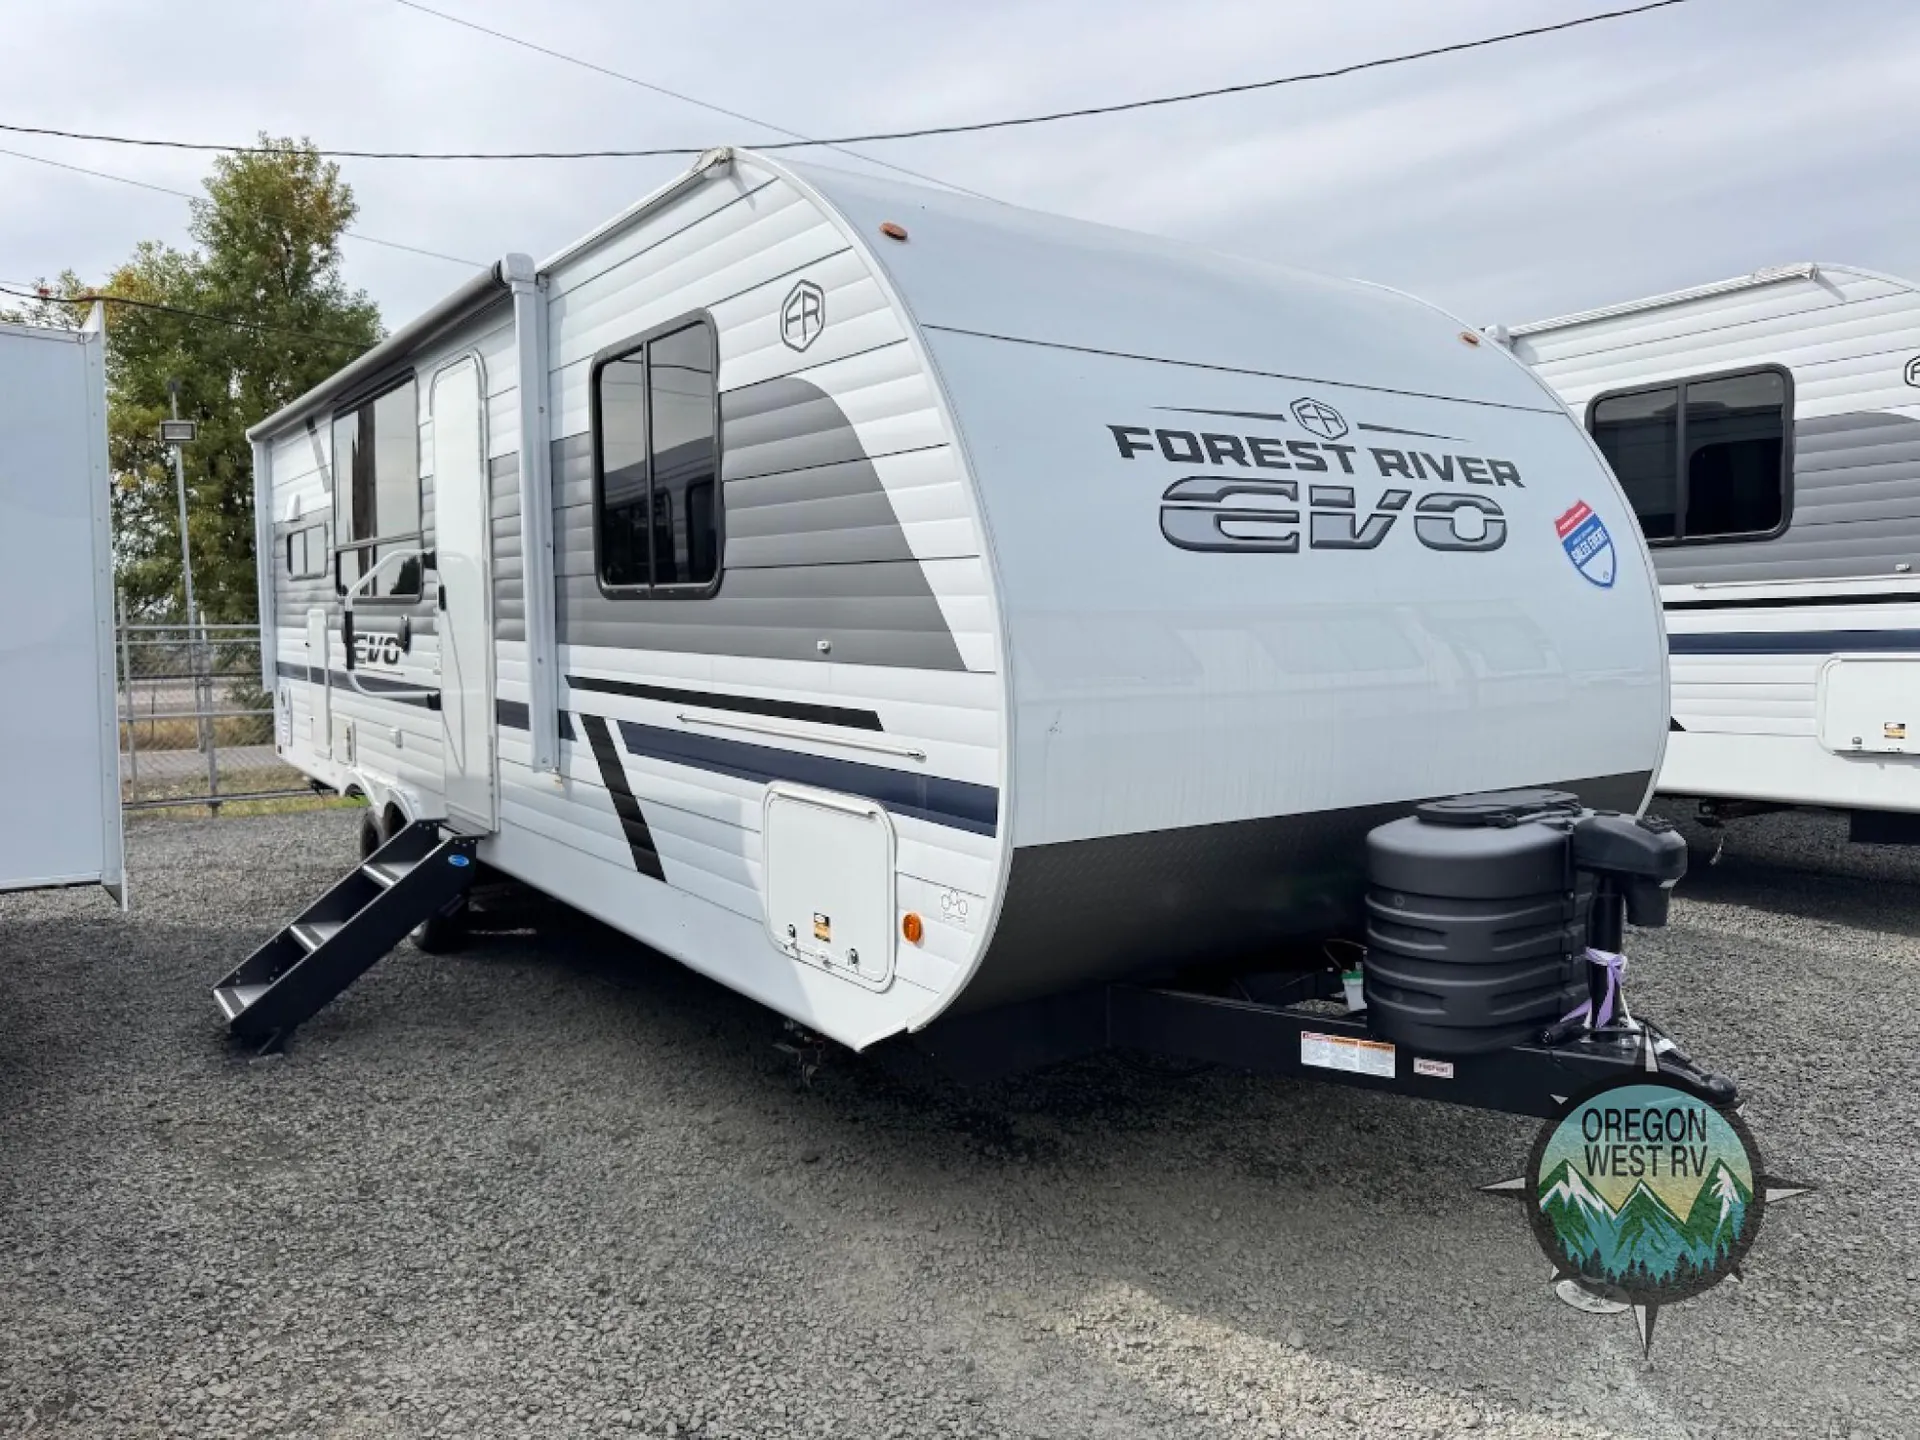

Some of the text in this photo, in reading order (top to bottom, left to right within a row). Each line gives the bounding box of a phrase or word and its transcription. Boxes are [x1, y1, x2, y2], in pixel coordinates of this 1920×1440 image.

[1106, 424, 1526, 489] FOREST RIVER
[1159, 475, 1508, 554] EVO
